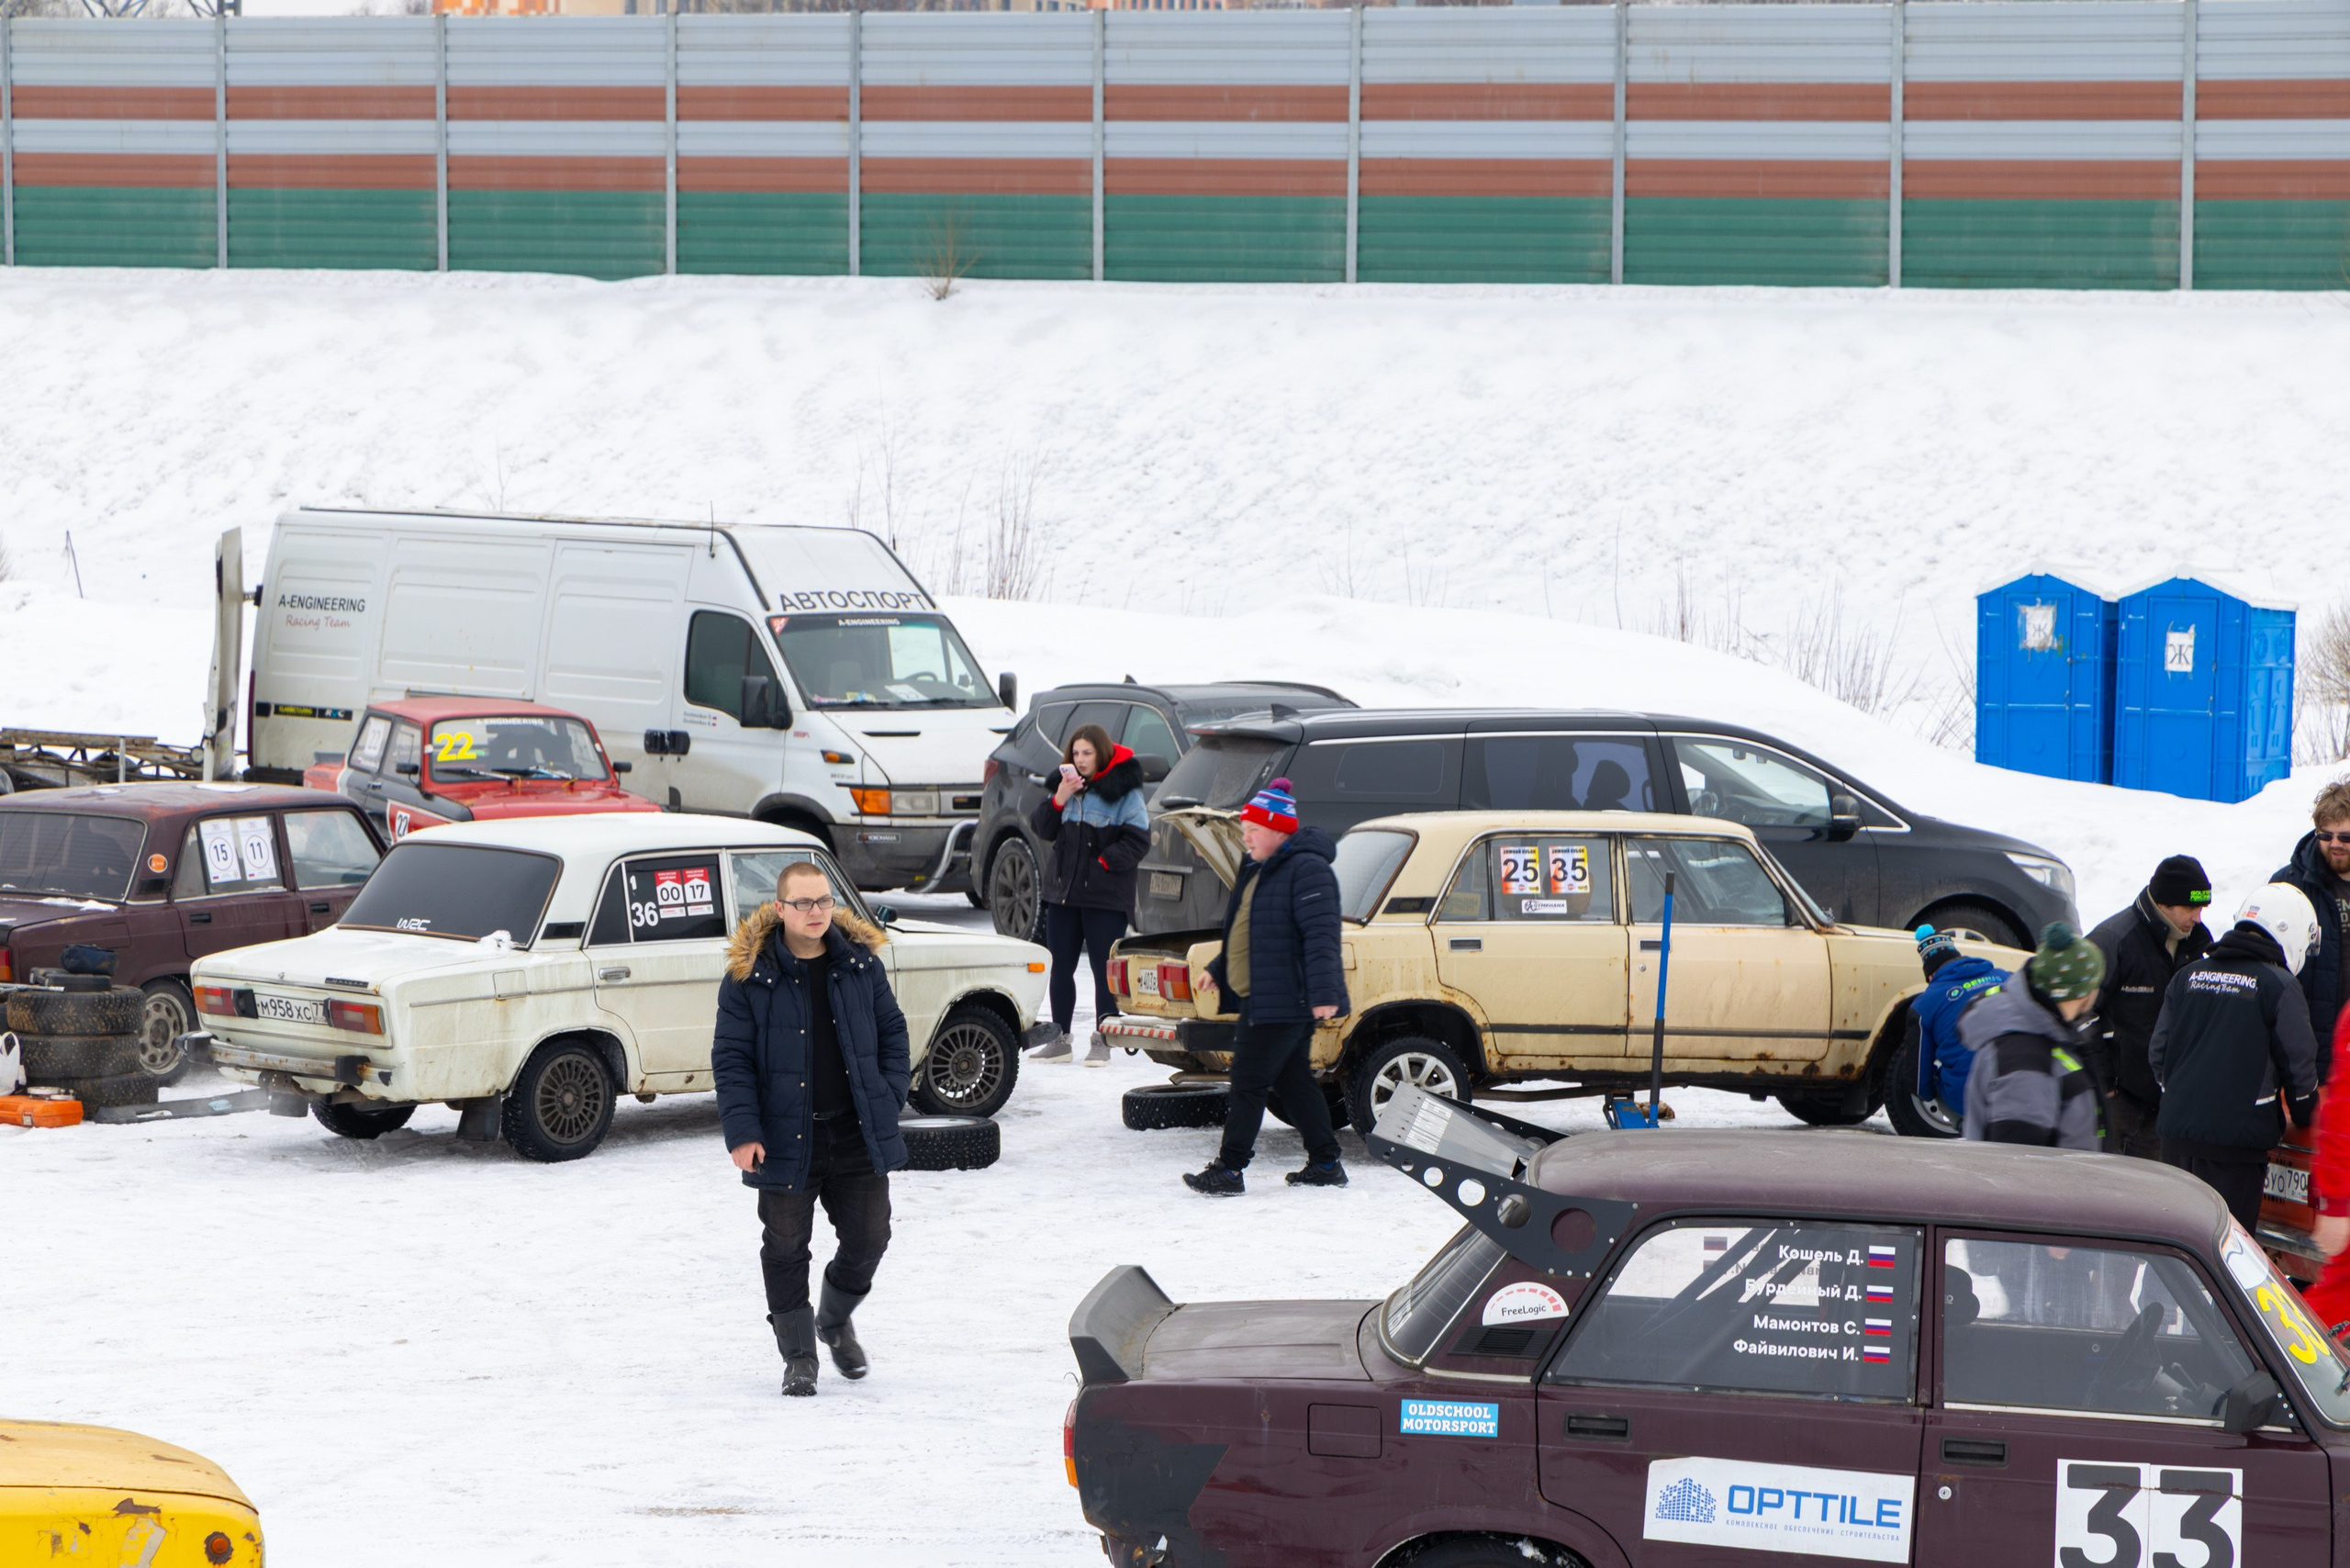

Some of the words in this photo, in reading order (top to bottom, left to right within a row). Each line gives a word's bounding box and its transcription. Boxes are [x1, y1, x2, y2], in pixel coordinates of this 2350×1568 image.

[278, 595, 365, 612] A-ENGINEERING
[778, 590, 926, 612] АВТОСПОРТ
[285, 614, 321, 631] Racing
[324, 616, 351, 628] Team
[837, 618, 901, 626] A-ENGINEERING
[2168, 644, 2193, 666] Ж
[435, 732, 476, 762] 22
[397, 813, 408, 837] 22
[213, 844, 229, 862] 15
[250, 842, 263, 860] 11
[1503, 858, 1539, 882] 25
[1551, 857, 1587, 882] 35
[660, 886, 680, 902] 00
[689, 884, 705, 900] 17
[397, 917, 431, 931] WRC
[631, 902, 659, 927] 36
[2188, 970, 2257, 989] A-ENGINEERING
[2190, 980, 2221, 994] Racing
[2288, 1169, 2307, 1192] 790
[1778, 1244, 1843, 1263] Кошель
[1846, 1249, 1864, 1266] Д.
[1745, 1278, 1841, 1299] Бурдейный
[1844, 1284, 1863, 1301] Д.
[1501, 1305, 1547, 1317] FreeLogic
[1753, 1314, 1840, 1334] Мамонтов
[1843, 1320, 1861, 1336] С.
[1732, 1338, 1838, 1360] Файвилович
[1842, 1346, 1860, 1361] И.
[1408, 1404, 1492, 1419] OLDSCHOOL
[1402, 1418, 1496, 1434] MOTORSPORT
[1727, 1484, 1903, 1529] OPTTILE
[2059, 1462, 2234, 1568] 33
[1725, 1518, 1778, 1531] КОМПЛЕКСНОЕ
[1784, 1524, 1835, 1537] ОБЕСПЕЧЕНИЕ
[1840, 1529, 1900, 1542] СТРОИТЕЛЬСТВА
